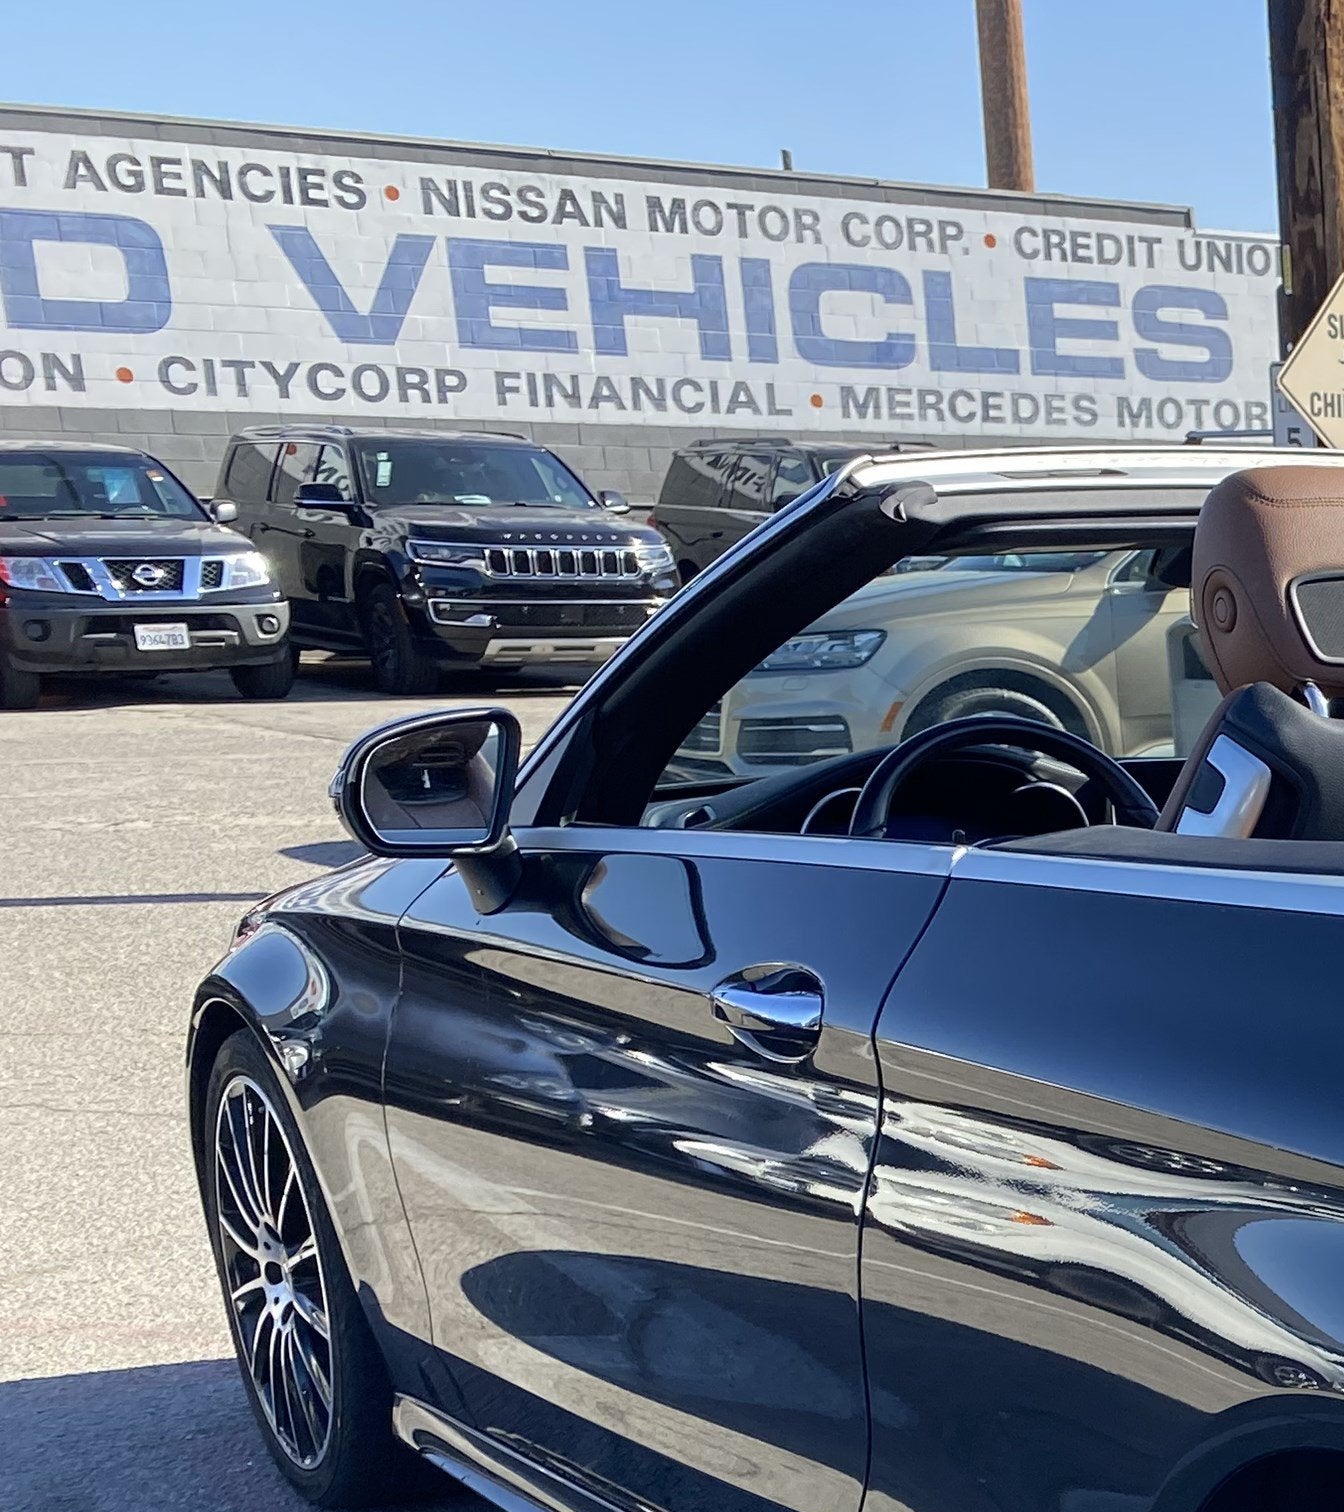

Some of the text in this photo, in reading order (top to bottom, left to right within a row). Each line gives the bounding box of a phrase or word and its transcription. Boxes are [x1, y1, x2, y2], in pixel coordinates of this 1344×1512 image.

[63, 149, 367, 211] AGENCIES
[419, 176, 969, 256] NISSAN MOTOR CORP.
[1013, 226, 1282, 278] CREDIT UNIO
[266, 224, 1233, 383] VEHICLES
[157, 355, 793, 417] CITYCORP FINANCIAL
[840, 385, 1269, 431] MERCEDES MOTOR
